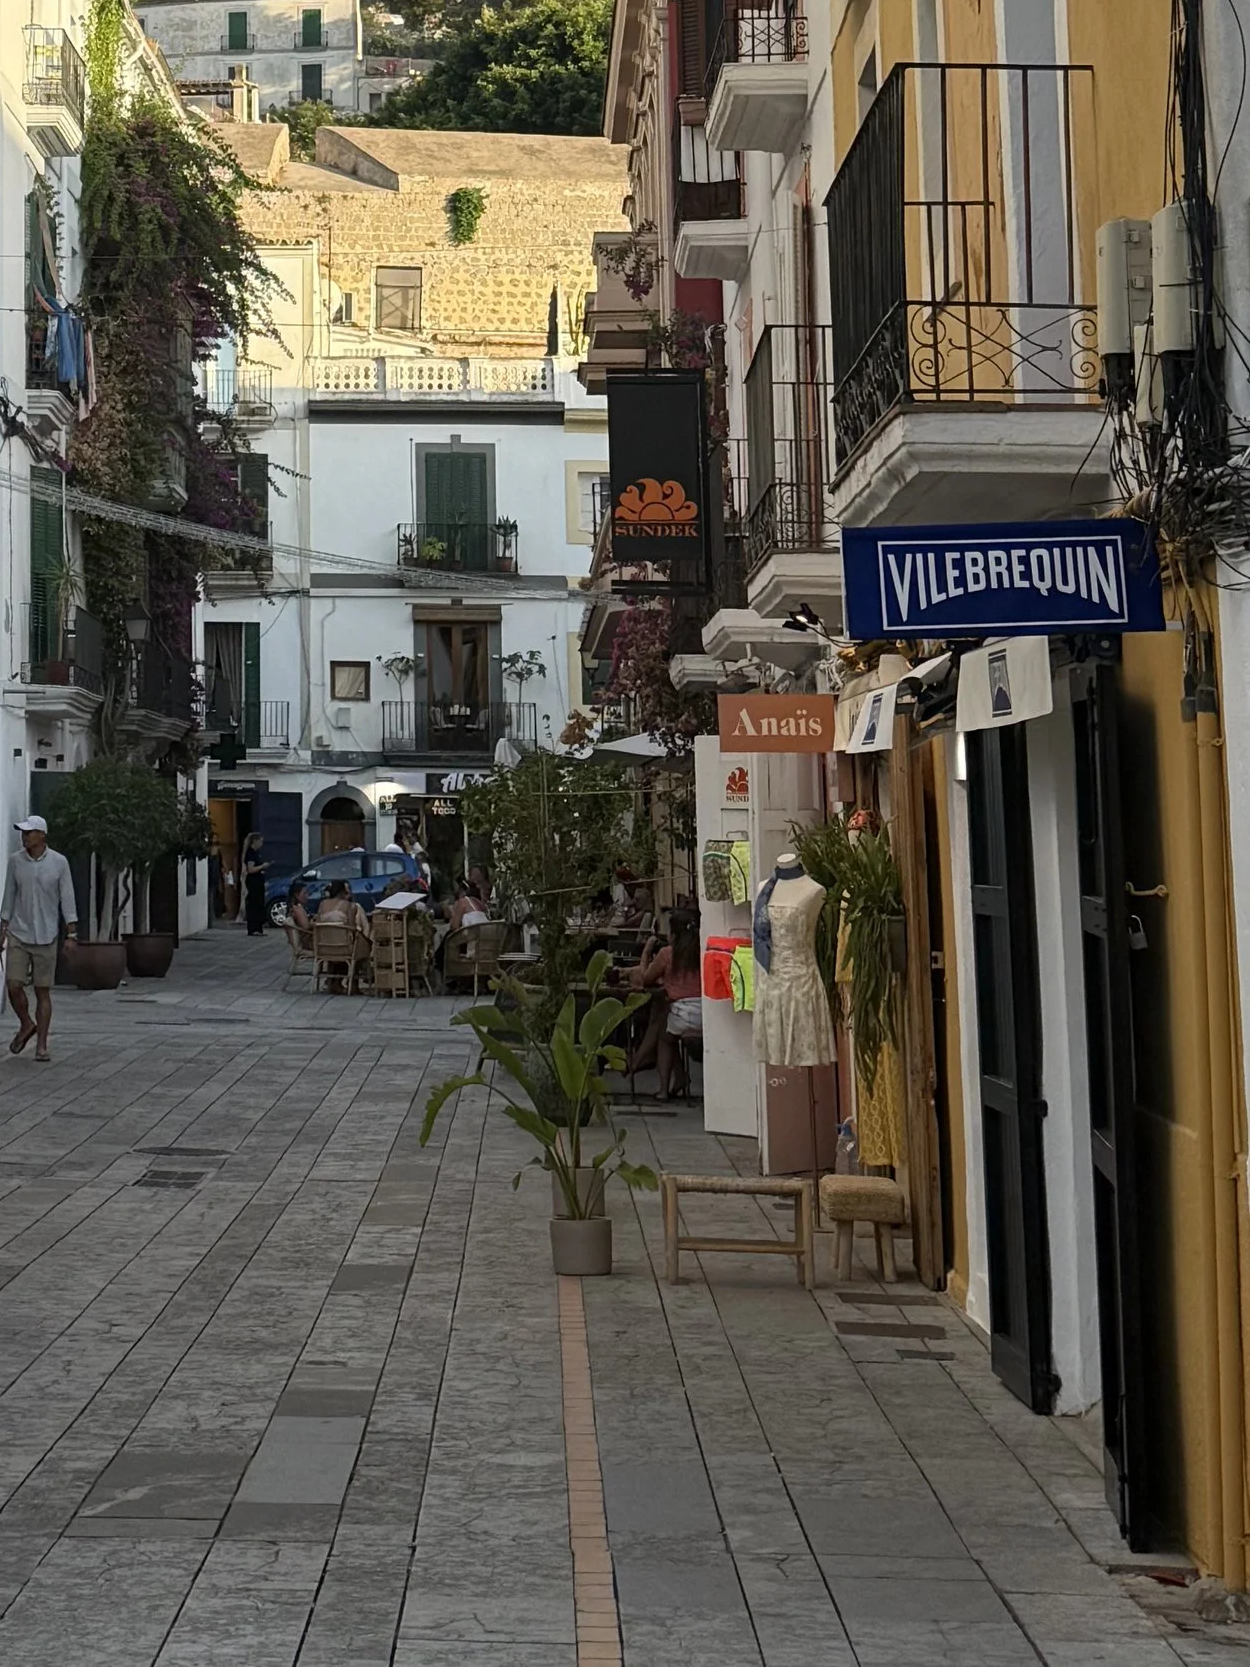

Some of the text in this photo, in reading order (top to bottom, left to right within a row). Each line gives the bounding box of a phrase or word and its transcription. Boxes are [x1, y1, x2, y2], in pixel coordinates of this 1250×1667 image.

[614, 525, 699, 537] SUNDEK
[887, 546, 1120, 622] VILEBREQUIN
[732, 709, 822, 736] Anaïs
[433, 799, 454, 807] ALL
